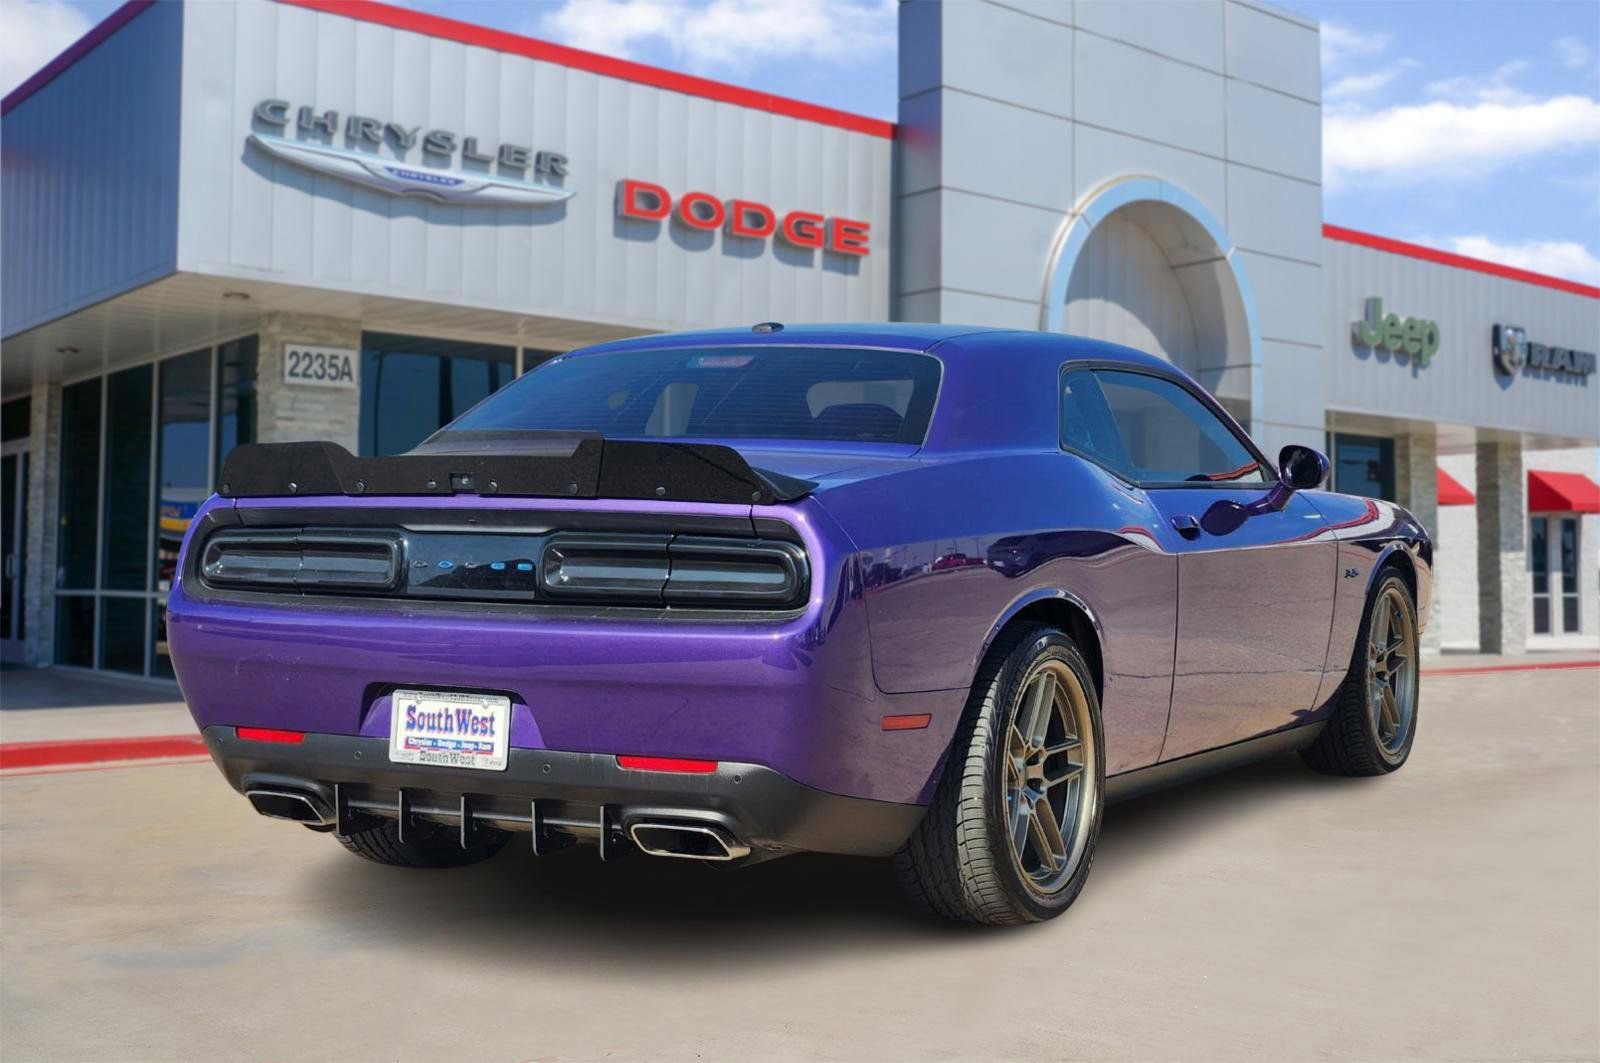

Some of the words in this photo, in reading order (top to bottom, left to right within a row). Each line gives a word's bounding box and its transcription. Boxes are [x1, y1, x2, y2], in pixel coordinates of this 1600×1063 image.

[252, 98, 570, 176] CHRYSLER
[615, 178, 870, 256] DODGE
[1353, 296, 1440, 364] Jeep
[288, 350, 353, 382] 2235A
[1527, 342, 1597, 374] RAM
[406, 704, 496, 736] SouthWest
